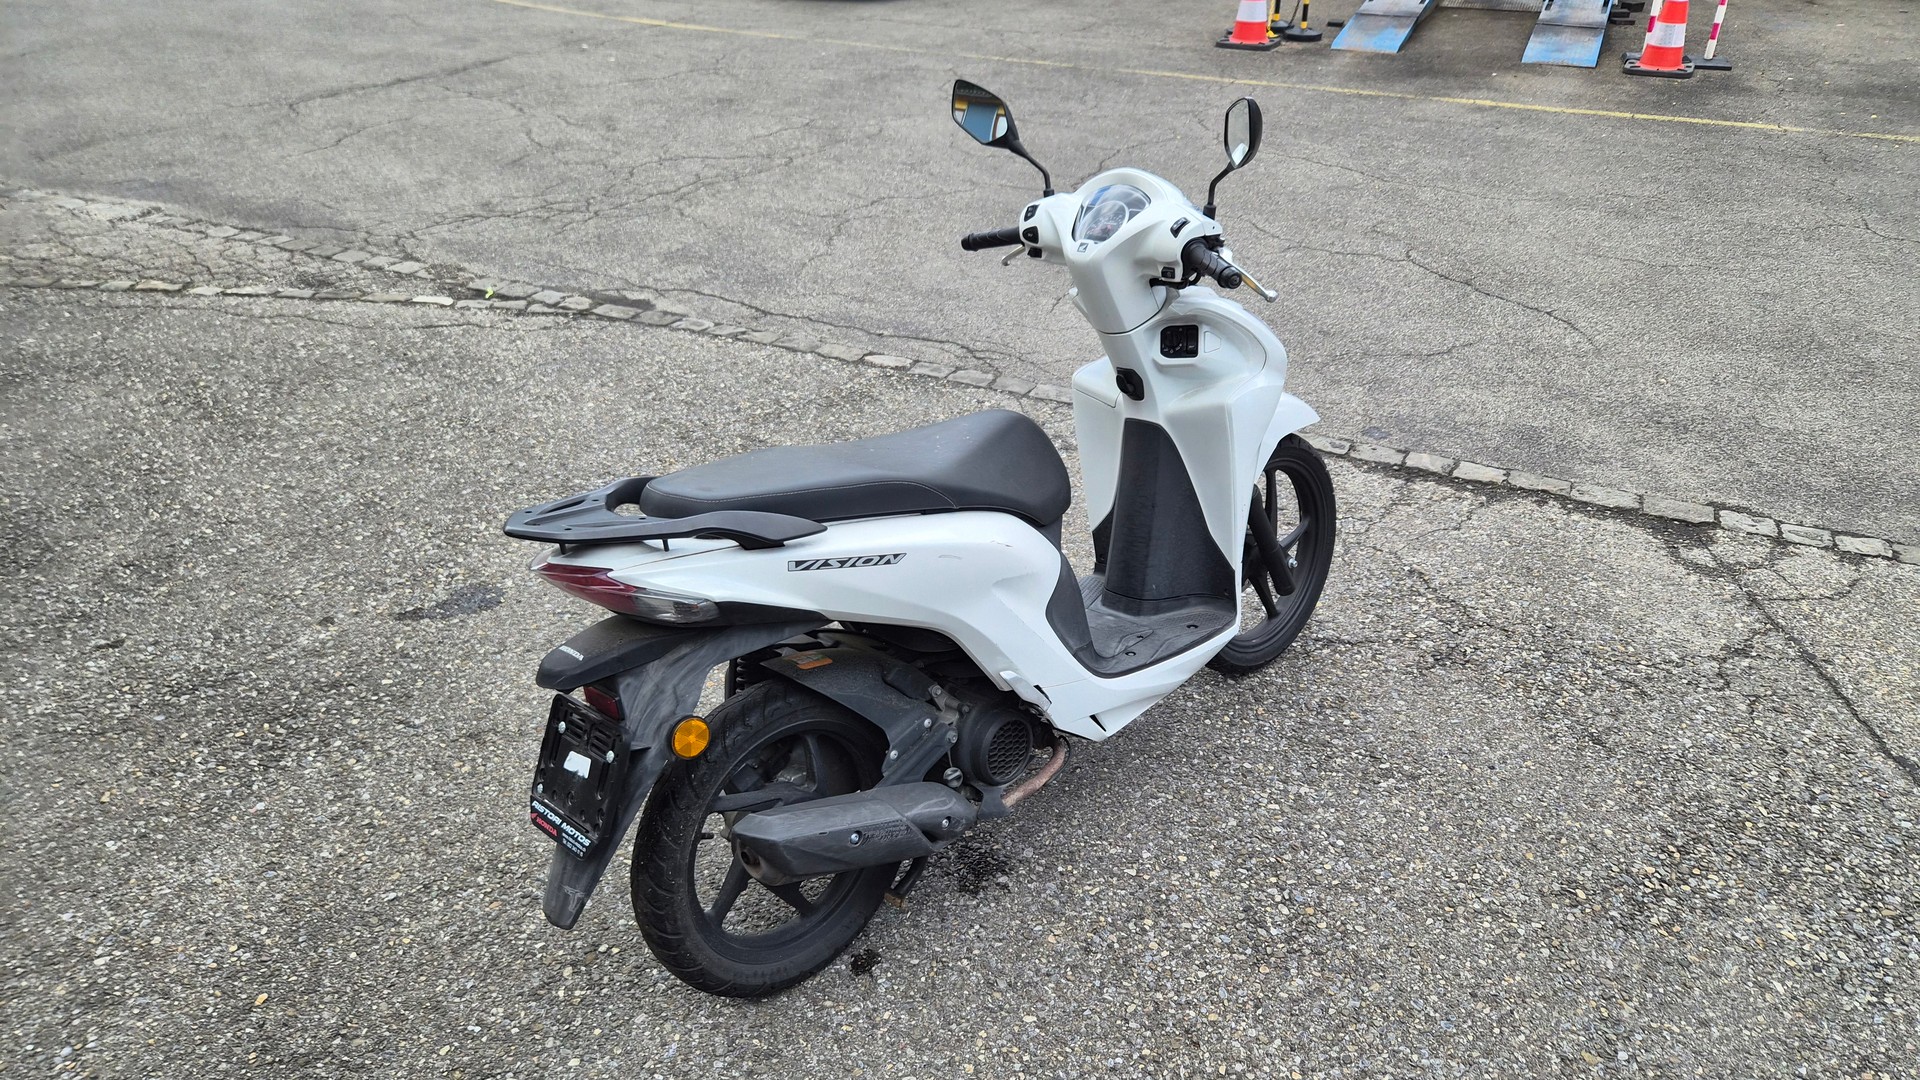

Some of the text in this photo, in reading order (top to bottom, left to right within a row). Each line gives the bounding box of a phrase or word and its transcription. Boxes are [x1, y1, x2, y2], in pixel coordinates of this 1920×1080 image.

[788, 553, 906, 571] VISION
[532, 800, 562, 825] RISTORI
[561, 822, 591, 846] MOTOS
[536, 816, 557, 836] HONDA
